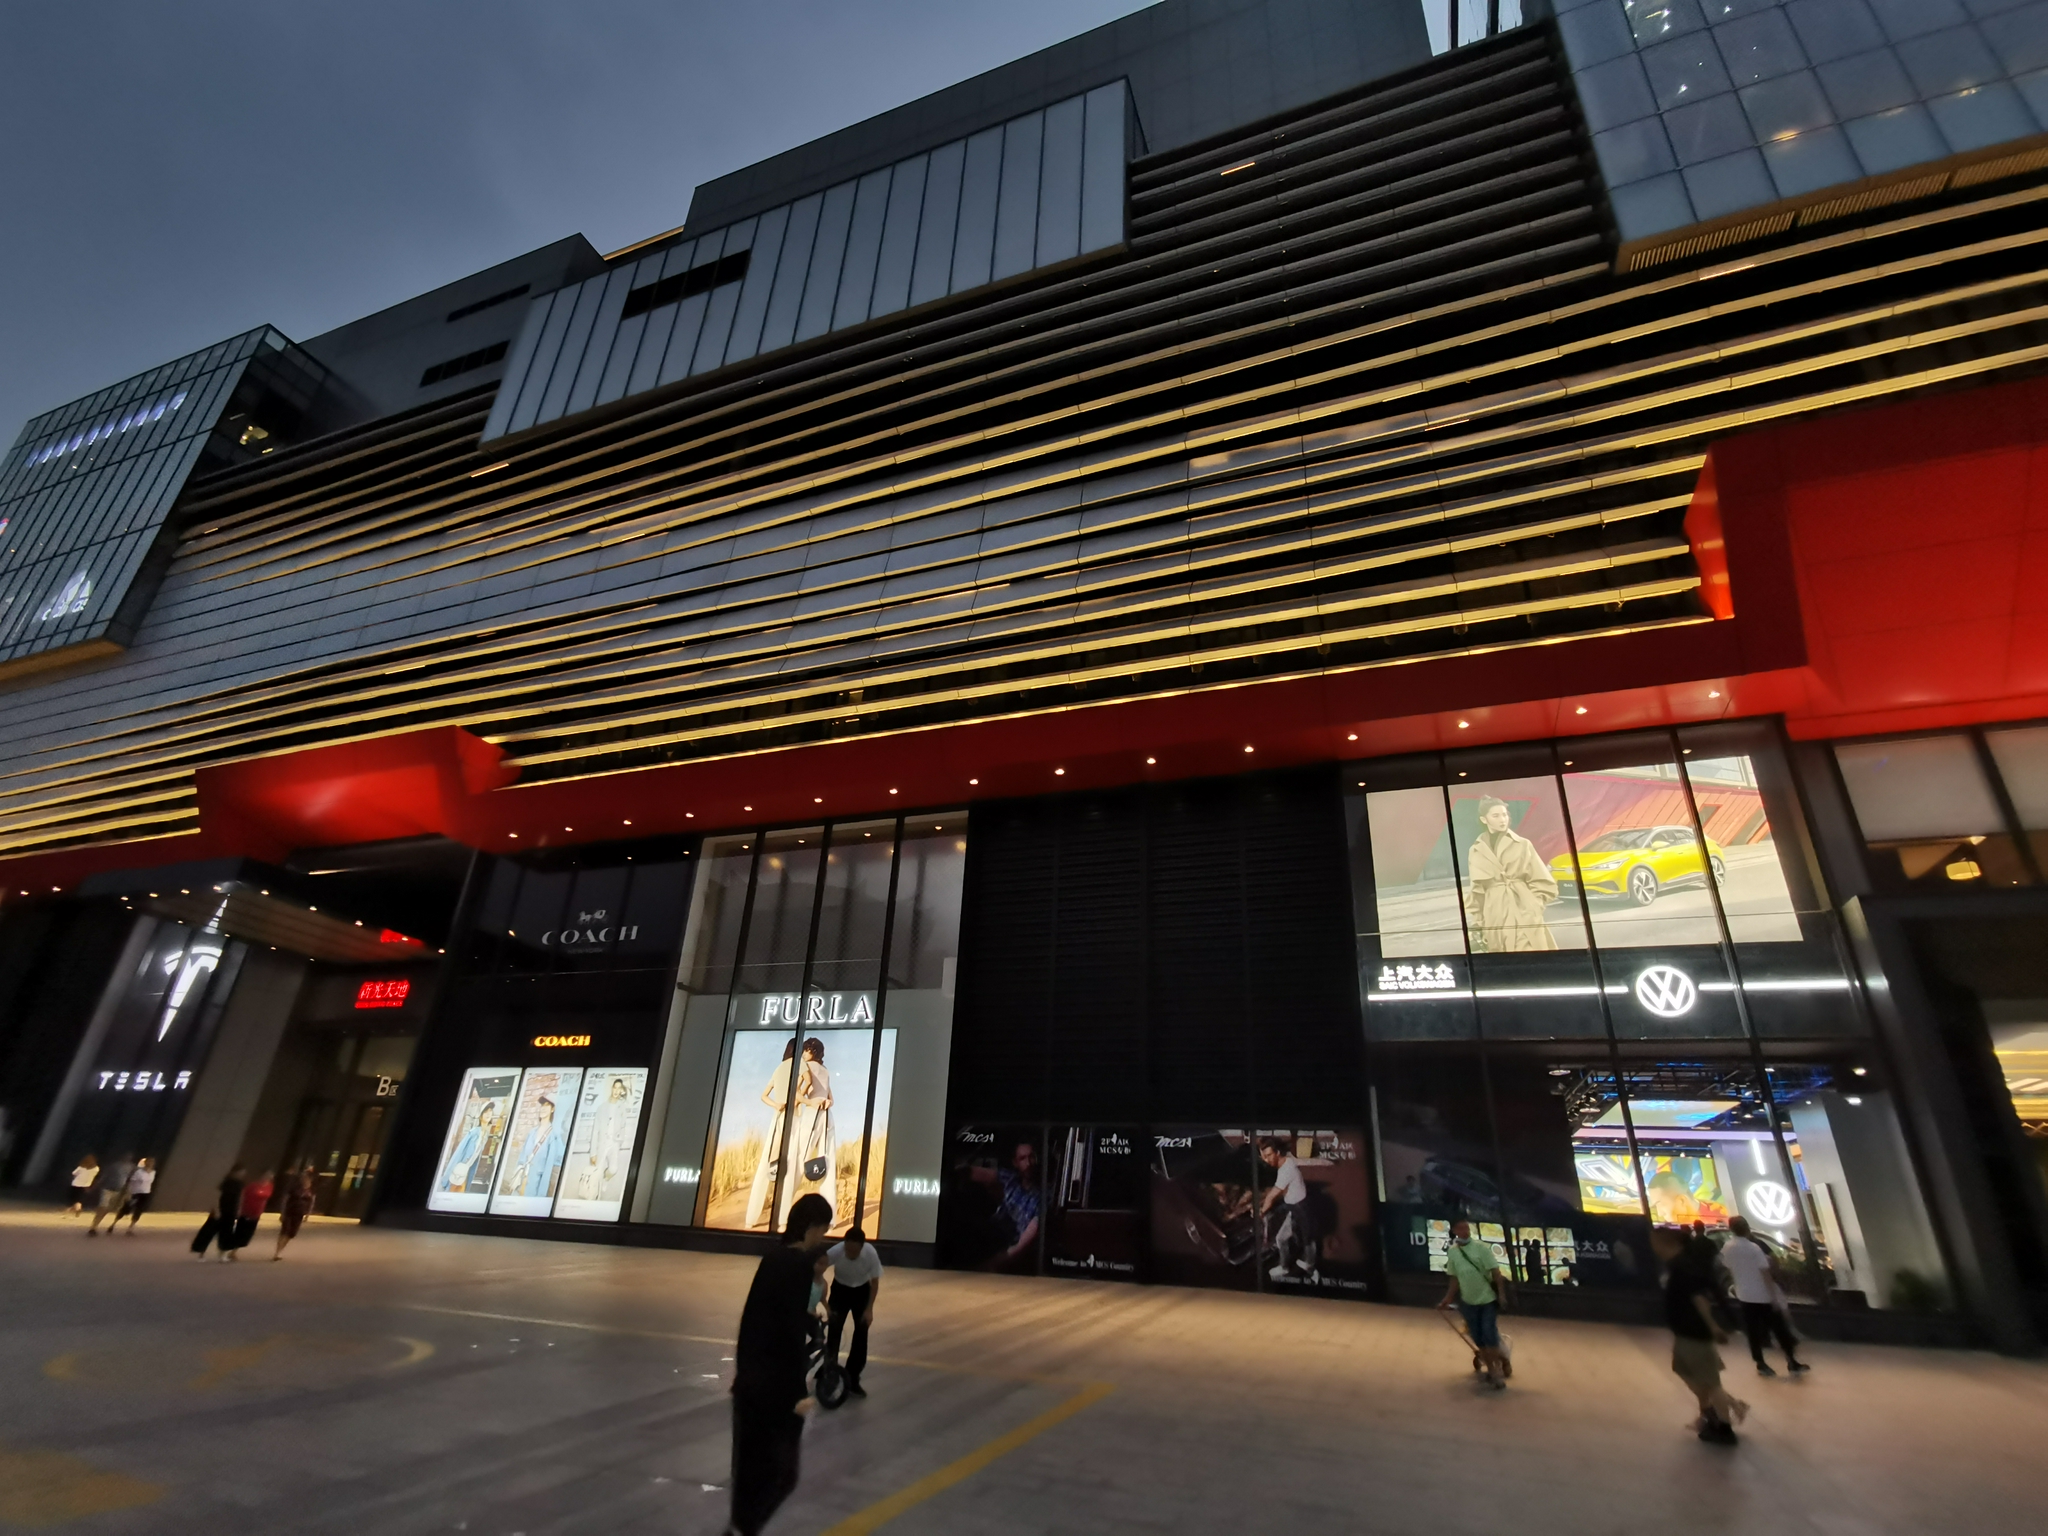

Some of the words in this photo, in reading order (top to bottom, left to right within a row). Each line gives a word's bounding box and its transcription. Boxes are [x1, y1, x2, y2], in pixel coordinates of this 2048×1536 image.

[541, 925, 639, 945] COACH
[1378, 963, 1454, 981] 上汽大众
[358, 979, 410, 999] 新光天地
[758, 994, 874, 1025] FURLA
[533, 1035, 592, 1047] COACH
[98, 1070, 193, 1091] TESLA
[893, 1177, 940, 1195] FURLA
